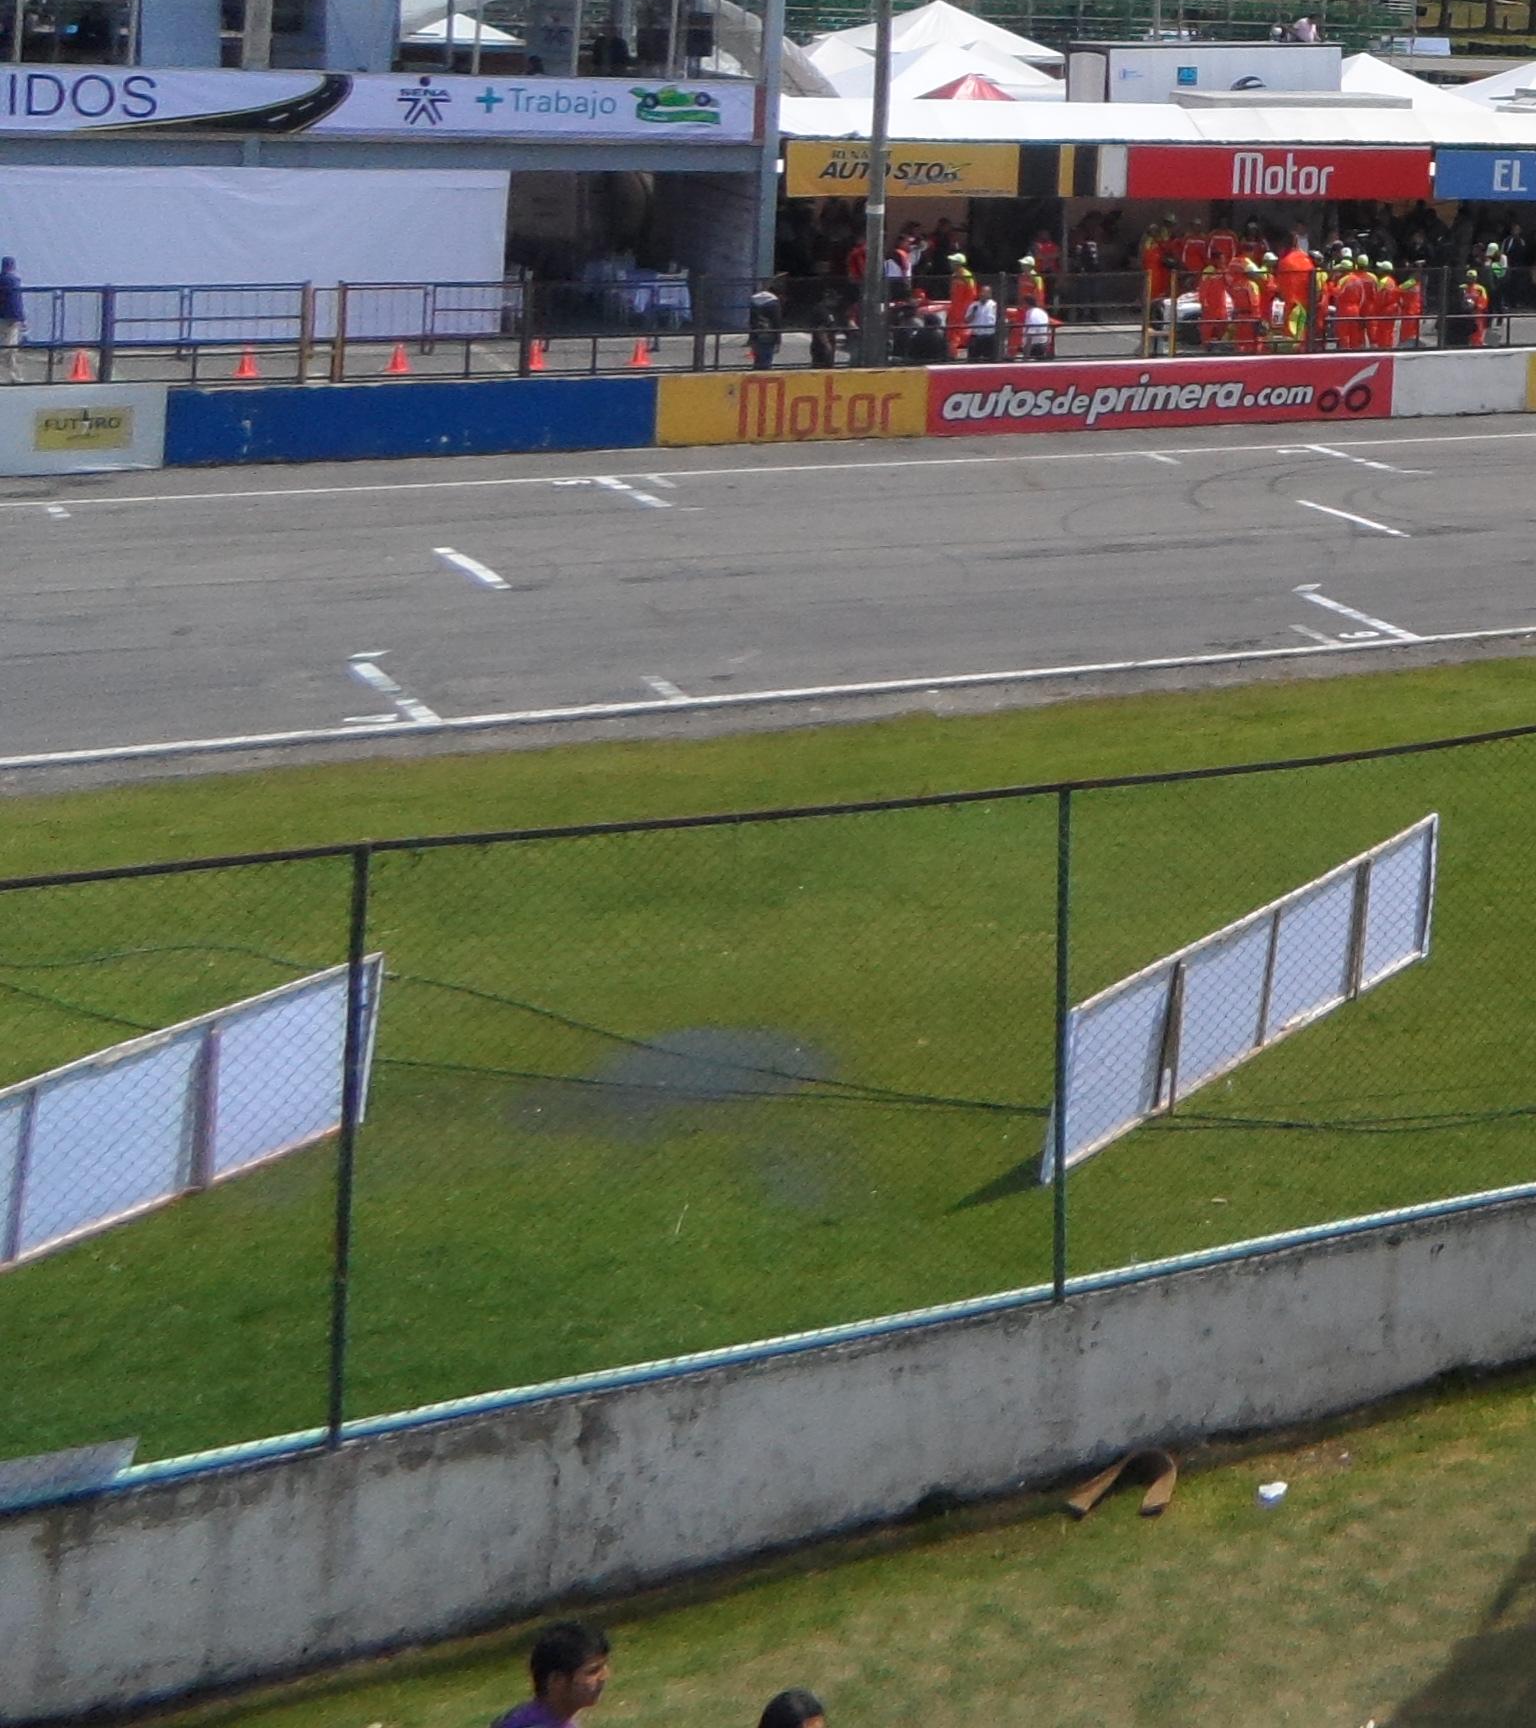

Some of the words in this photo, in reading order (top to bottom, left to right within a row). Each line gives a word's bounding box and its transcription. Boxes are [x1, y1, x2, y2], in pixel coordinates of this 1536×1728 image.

[400, 88, 450, 97] SENA
[1232, 152, 1334, 195] Motor
[1492, 158, 1527, 192] EL
[738, 374, 903, 441] Motor
[941, 373, 1314, 425] autosdeprimera.com
